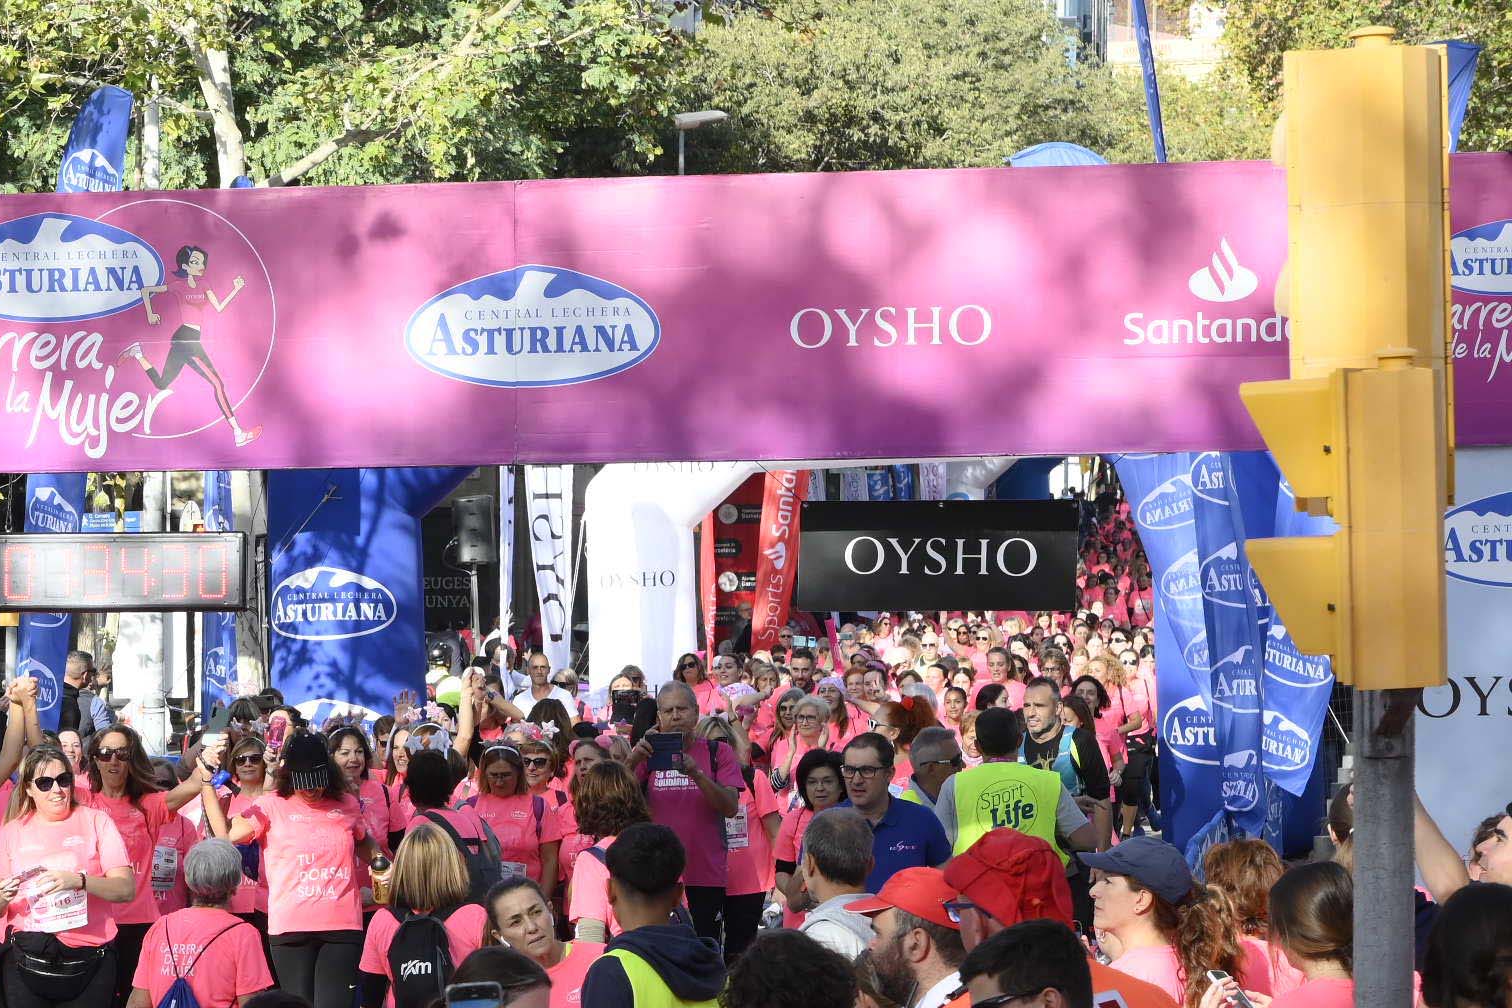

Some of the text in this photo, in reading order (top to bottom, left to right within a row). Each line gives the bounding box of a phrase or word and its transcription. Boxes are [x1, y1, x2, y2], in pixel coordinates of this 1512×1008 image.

[67, 249, 139, 263] LECHERA
[465, 305, 633, 321] CENTRAL LECHERA
[426, 312, 641, 357] ASTURIANA
[789, 304, 993, 349] OYSHO
[5, 373, 31, 413] la
[26, 363, 175, 459] Mujer
[843, 535, 1039, 577] OYSHO
[423, 576, 471, 591] EUGES
[287, 591, 384, 601] CENTRAL LECHERA
[426, 593, 471, 609] UNYA
[274, 600, 387, 625] ASTURIANA
[981, 783, 1025, 810] Sport
[990, 799, 1034, 829] Life
[296, 854, 315, 866] TU
[298, 866, 350, 884] DORSAL
[296, 885, 337, 898] SUMA
